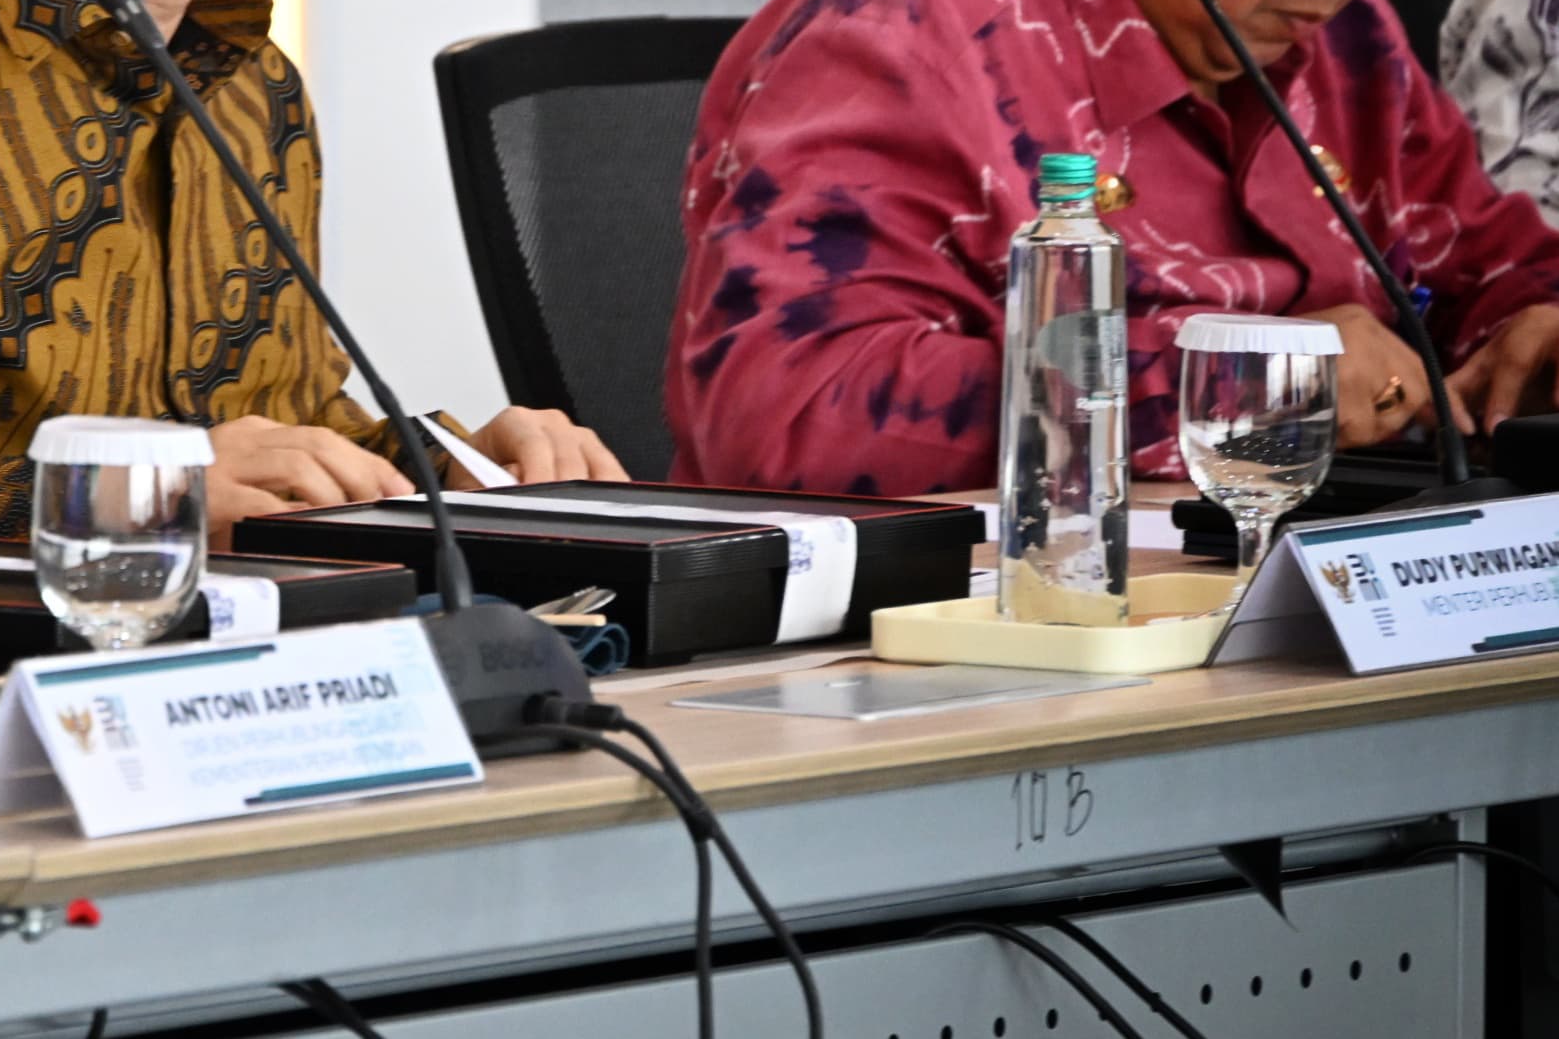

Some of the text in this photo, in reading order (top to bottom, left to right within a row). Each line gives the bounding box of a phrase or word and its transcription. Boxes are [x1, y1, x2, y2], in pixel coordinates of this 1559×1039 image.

[1391, 555, 1450, 587] DUDY
[165, 673, 398, 727] ANTONI ARIF PRIADI
[1064, 766, 1094, 837] B
